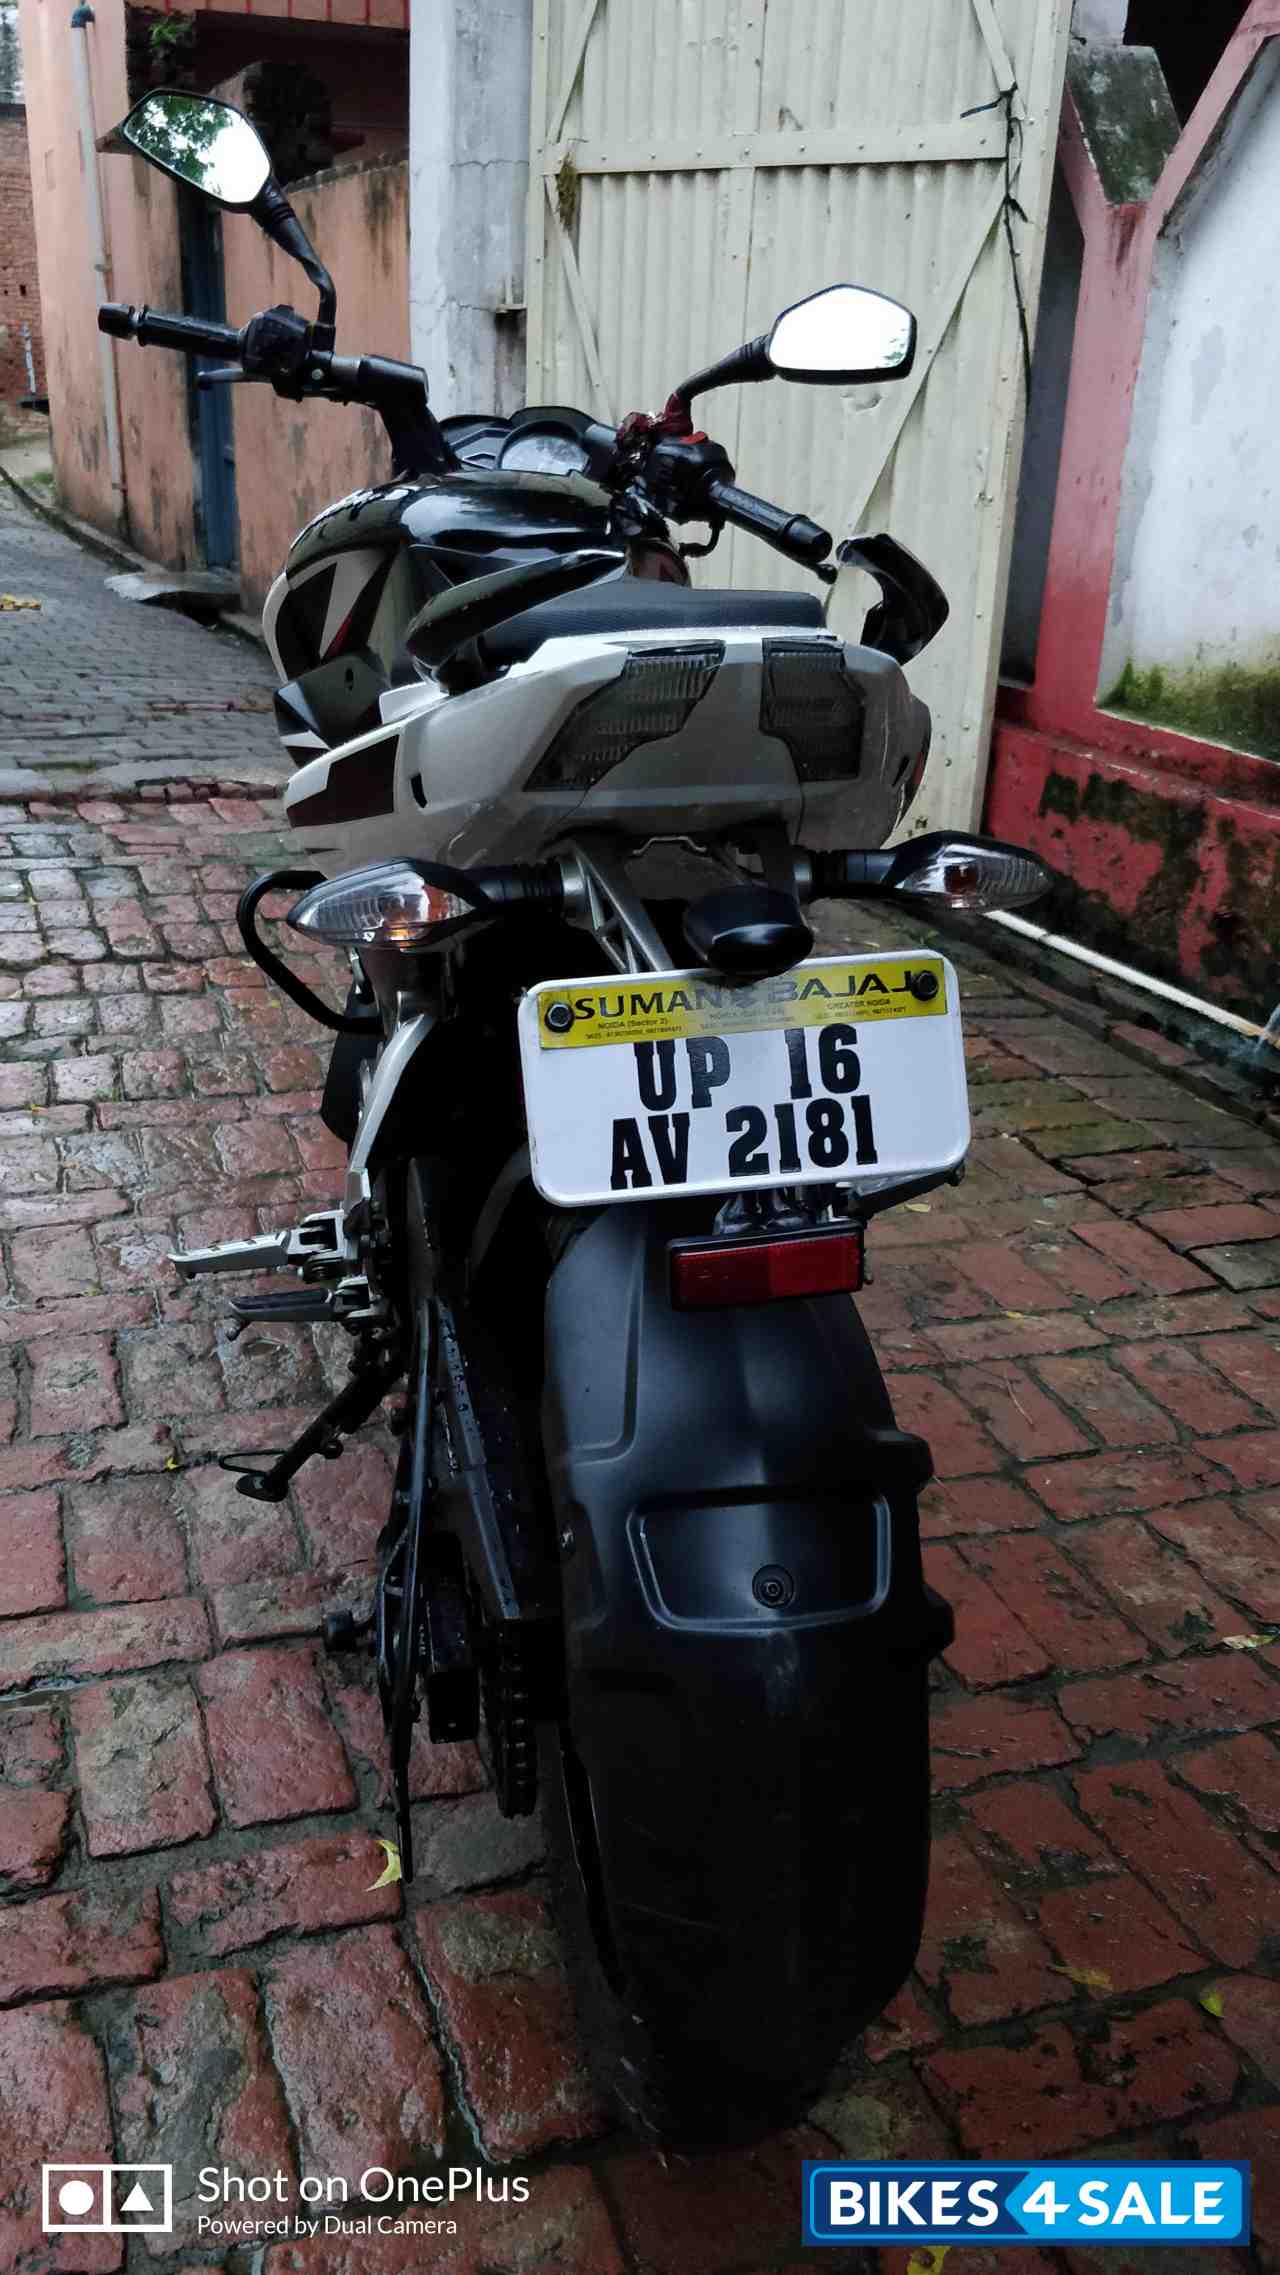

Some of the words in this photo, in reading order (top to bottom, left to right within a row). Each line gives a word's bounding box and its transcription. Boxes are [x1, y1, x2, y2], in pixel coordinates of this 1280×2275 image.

[767, 970, 912, 1003] BAJAJ
[634, 1036, 731, 1111] UP
[785, 1022, 861, 1099] 16
[610, 1112, 690, 1190] AV
[726, 1095, 878, 1177] 2181
